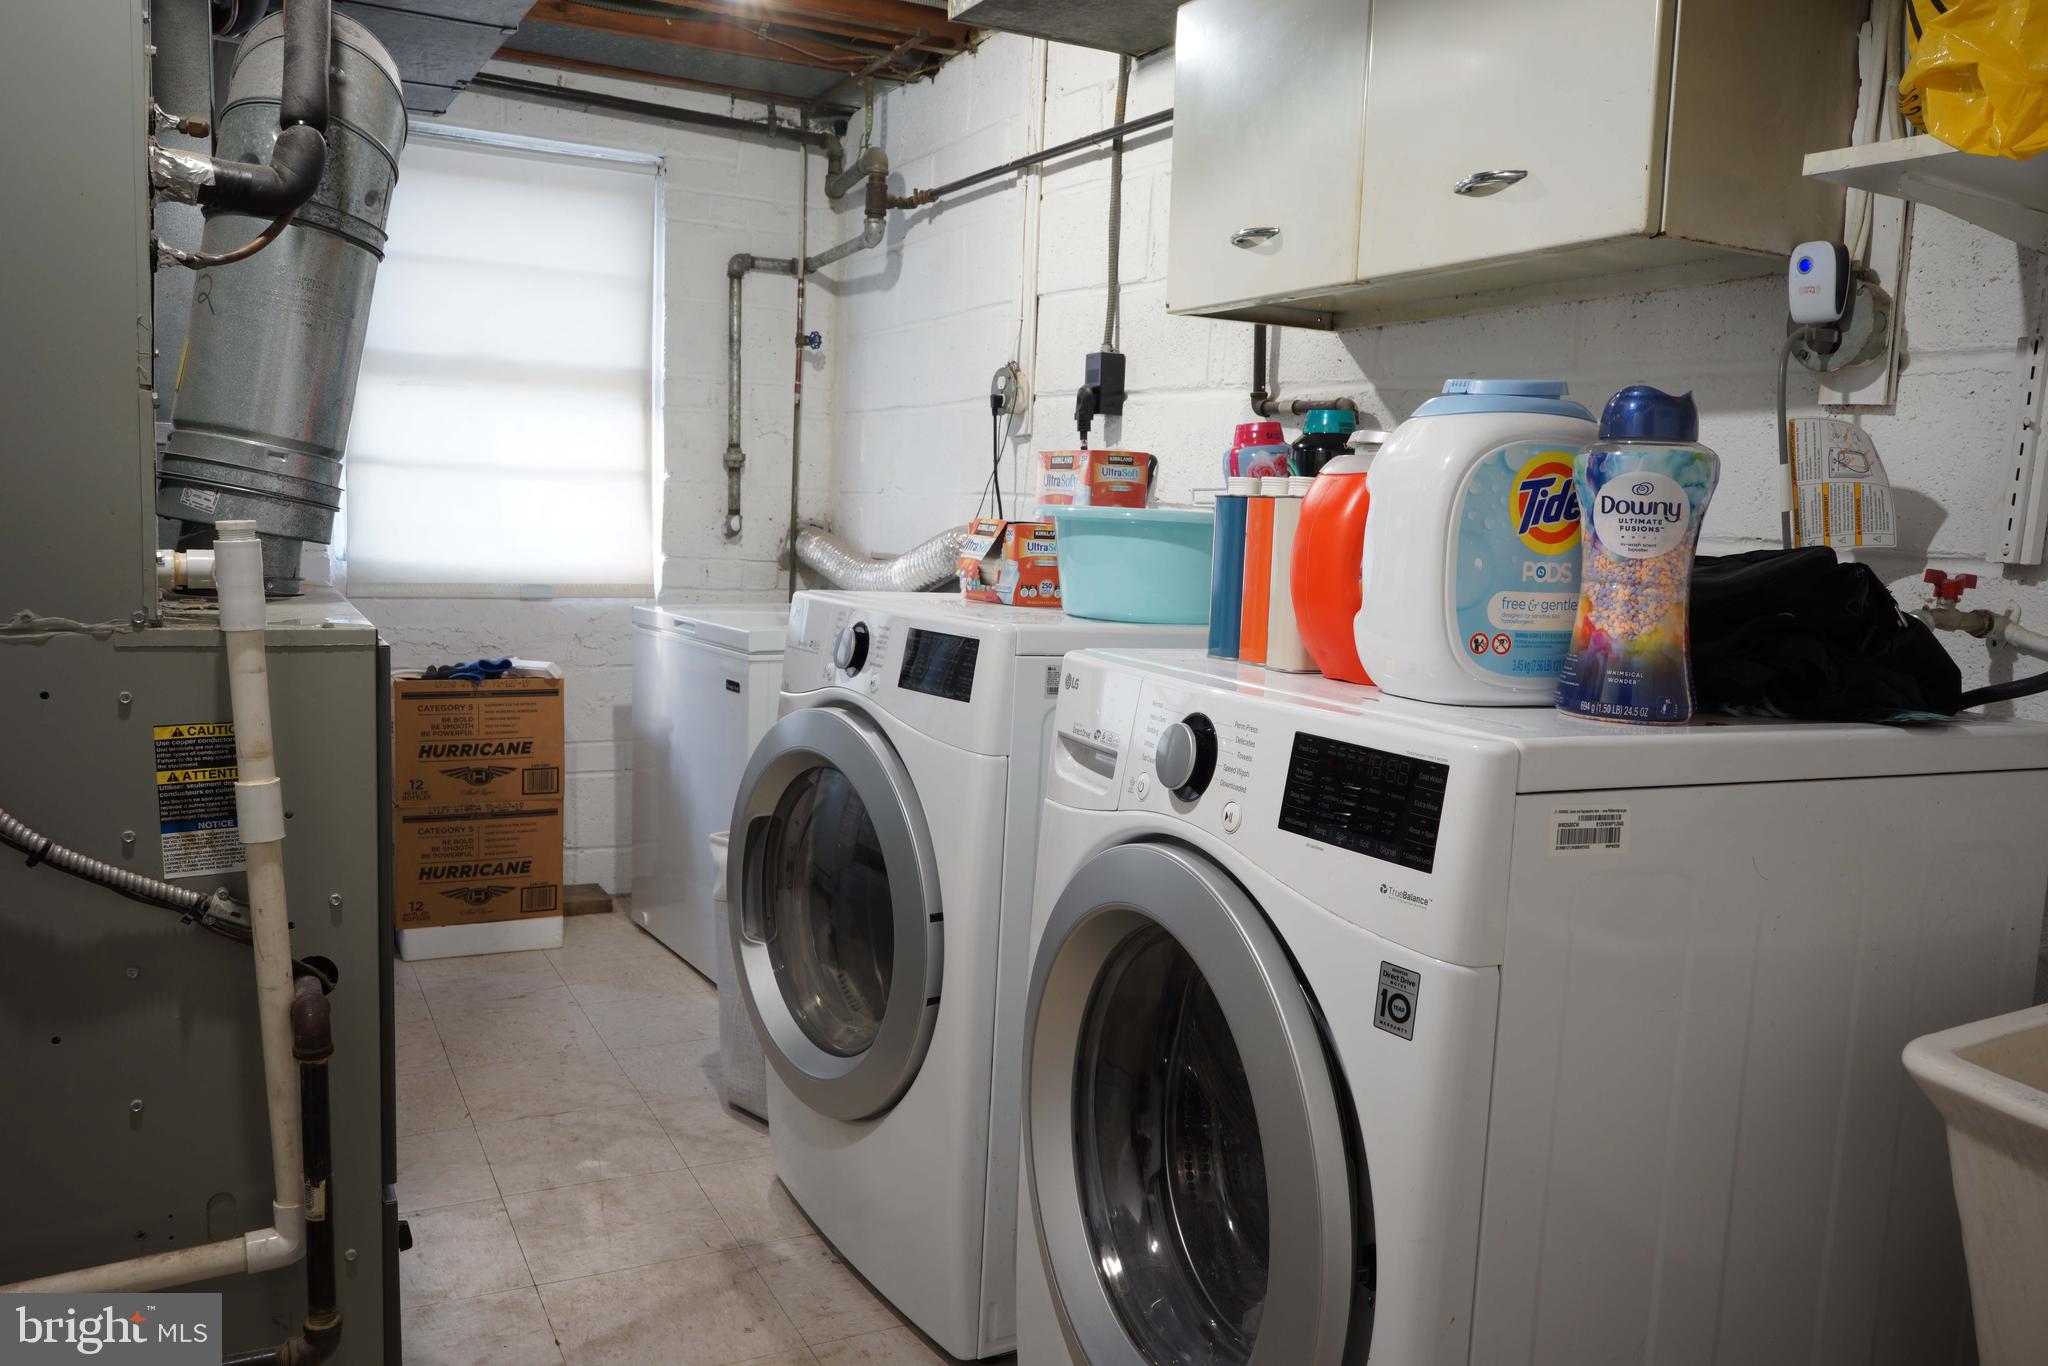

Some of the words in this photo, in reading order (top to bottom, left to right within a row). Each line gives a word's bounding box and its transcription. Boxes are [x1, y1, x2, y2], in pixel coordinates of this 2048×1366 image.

[1101, 467, 1139, 477] UltraSoft
[1518, 477, 1580, 535] Tide
[1601, 495, 1681, 524] Downy
[1027, 542, 1056, 552] UltraSo
[1522, 561, 1573, 583] PODS
[1502, 597, 1526, 610] free
[1528, 599, 1539, 611] &
[1541, 597, 1577, 614] gentle
[1606, 669, 1644, 678] WHIMSICAL
[1071, 676, 1079, 689] LG
[417, 704, 464, 712] CATEGORY
[1596, 703, 1611, 714] (1.50
[1612, 705, 1622, 715] LB)
[1624, 706, 1639, 716] 24.5
[1640, 707, 1649, 717] OZ
[187, 725, 234, 736] CAUTIO
[1235, 736, 1255, 748] Delicates
[418, 741, 533, 758] HURRICANE
[1237, 752, 1253, 762] Towels
[182, 768, 238, 781] ATTENTI
[1223, 764, 1237, 775] Speed
[409, 780, 424, 790] 12
[1219, 780, 1247, 794] Downloaded
[198, 820, 234, 830] NOTICE
[418, 827, 464, 835] CATEGORY
[418, 861, 533, 881] HURRICANE
[409, 901, 424, 911] 12
[1383, 970, 1399, 980] Direct
[1400, 976, 1415, 987] Drive
[1380, 988, 1411, 1023] 10
[1394, 1005, 1405, 1013] YEAR
[1380, 1020, 1407, 1033] WARRANTY
